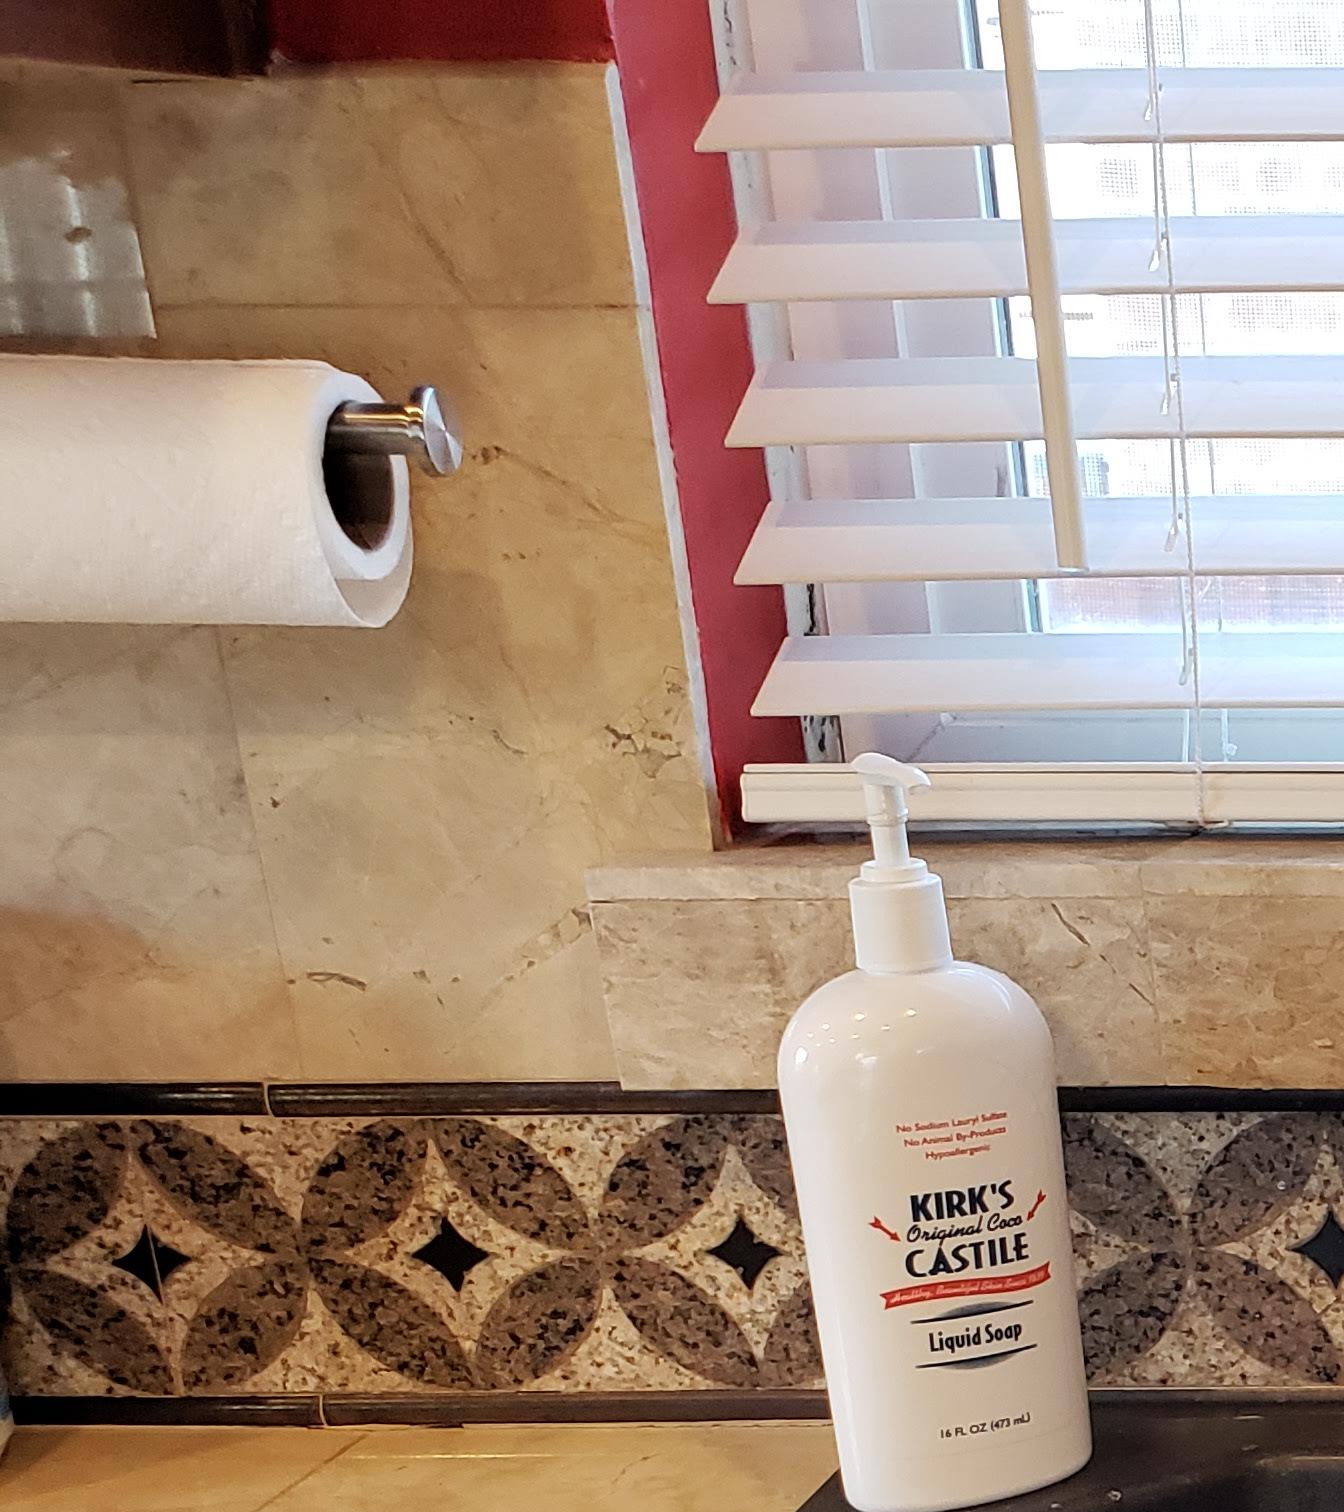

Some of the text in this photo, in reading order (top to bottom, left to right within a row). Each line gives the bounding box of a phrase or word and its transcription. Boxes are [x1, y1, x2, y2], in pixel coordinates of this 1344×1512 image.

[896, 1125, 912, 1133] No
[915, 1121, 949, 1132] Sodium
[904, 1139, 920, 1147] No
[921, 1134, 953, 1145] Animal
[910, 1180, 1015, 1222] KIRK'S
[907, 1213, 1023, 1248] Original Coco
[905, 1232, 1029, 1278] CASTILE
[929, 1323, 1022, 1353] Liquid Soap
[941, 1429, 952, 1438] 16
[955, 1427, 967, 1437] FL
[969, 1422, 987, 1434] OZ
[990, 1418, 1011, 1432] (473
